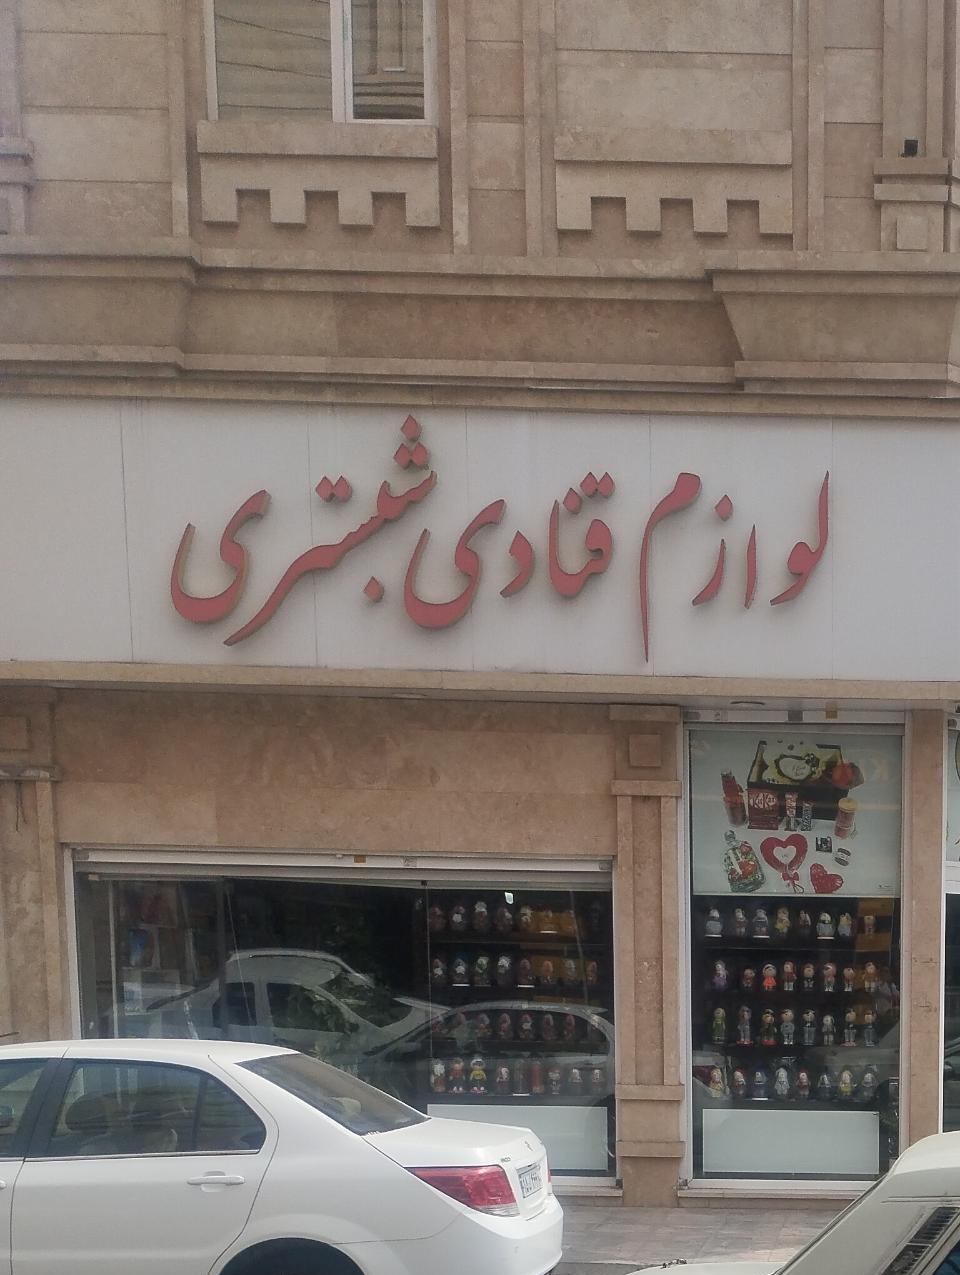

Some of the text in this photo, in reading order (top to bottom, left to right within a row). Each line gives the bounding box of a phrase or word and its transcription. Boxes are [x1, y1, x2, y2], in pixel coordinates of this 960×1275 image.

[170, 413, 831, 663] لوازم قنادی شبستری
